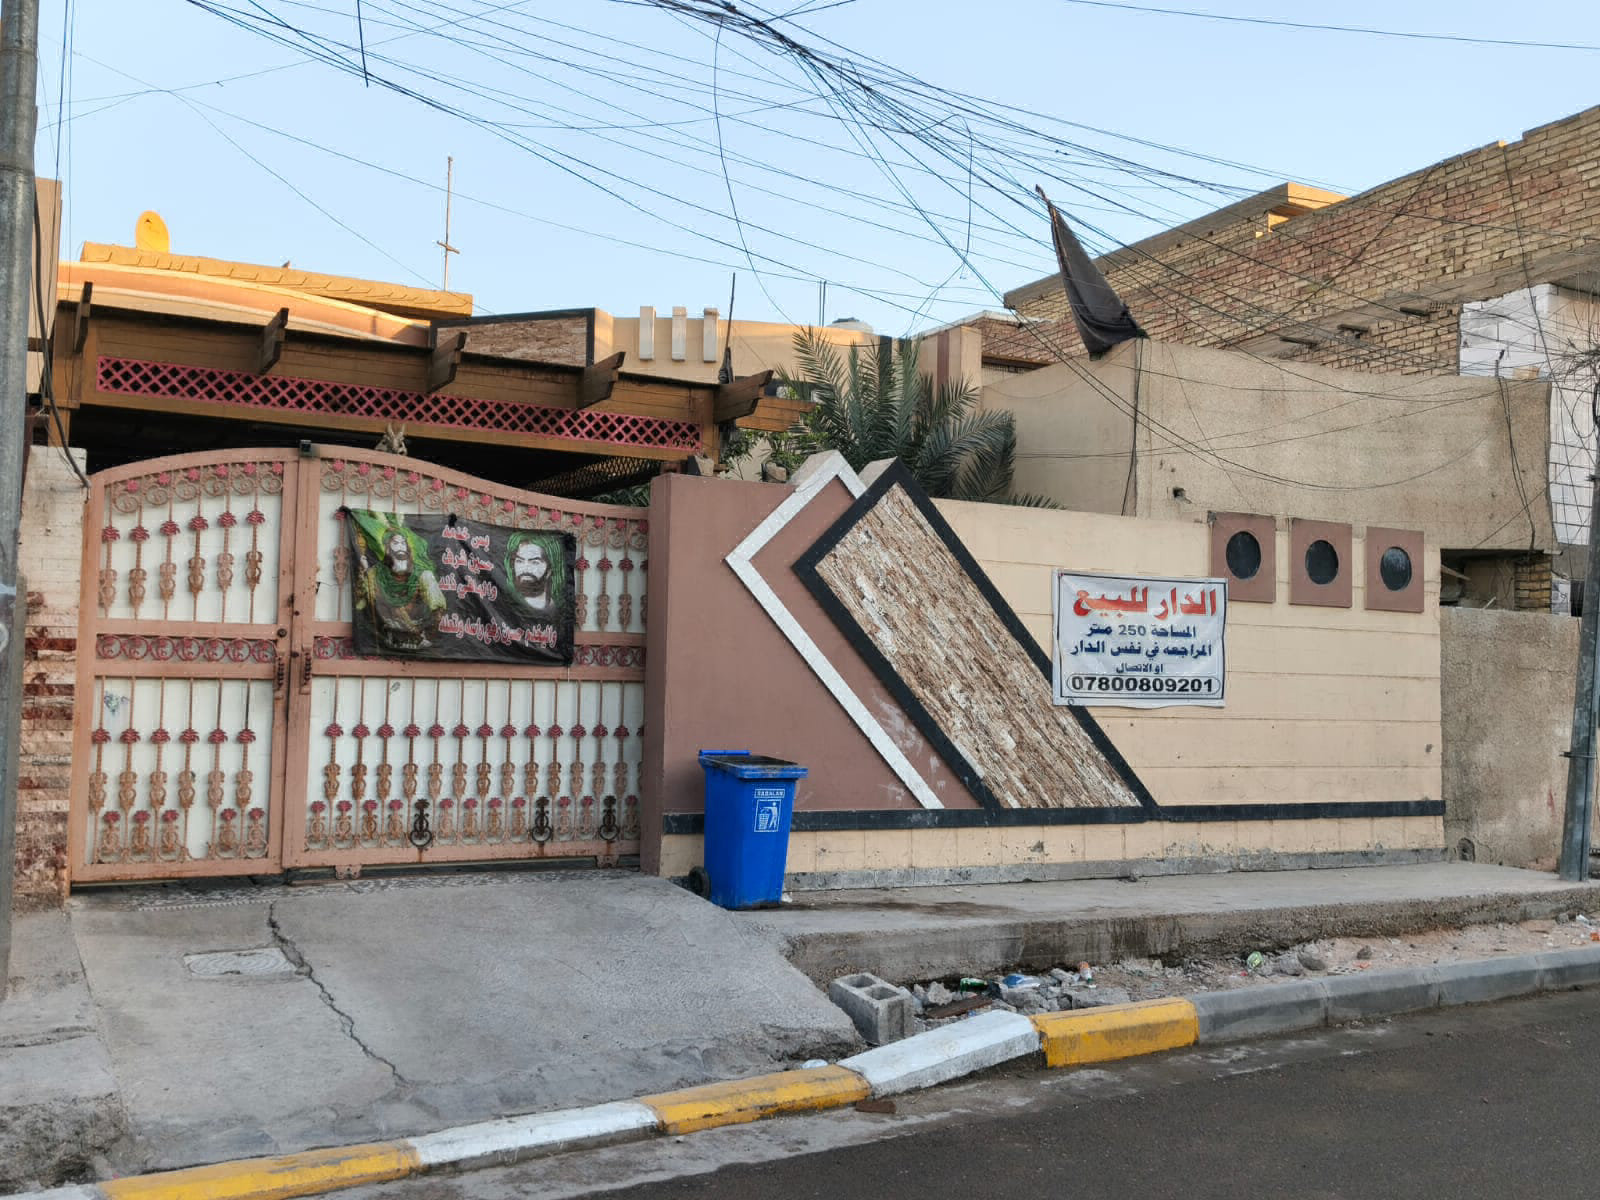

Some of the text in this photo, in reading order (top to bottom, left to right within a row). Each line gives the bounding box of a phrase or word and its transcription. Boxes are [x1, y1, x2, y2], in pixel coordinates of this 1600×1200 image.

[468, 552, 494, 574] حسين
[1073, 586, 1217, 620] الدار للبيع
[500, 621, 525, 645] حسين
[1087, 623, 1196, 638] المساحة 250 متر
[1070, 640, 1105, 655] الدار
[1111, 642, 1141, 656] نفس
[1145, 642, 1159, 660] في
[1071, 676, 1213, 692] 07800809201
